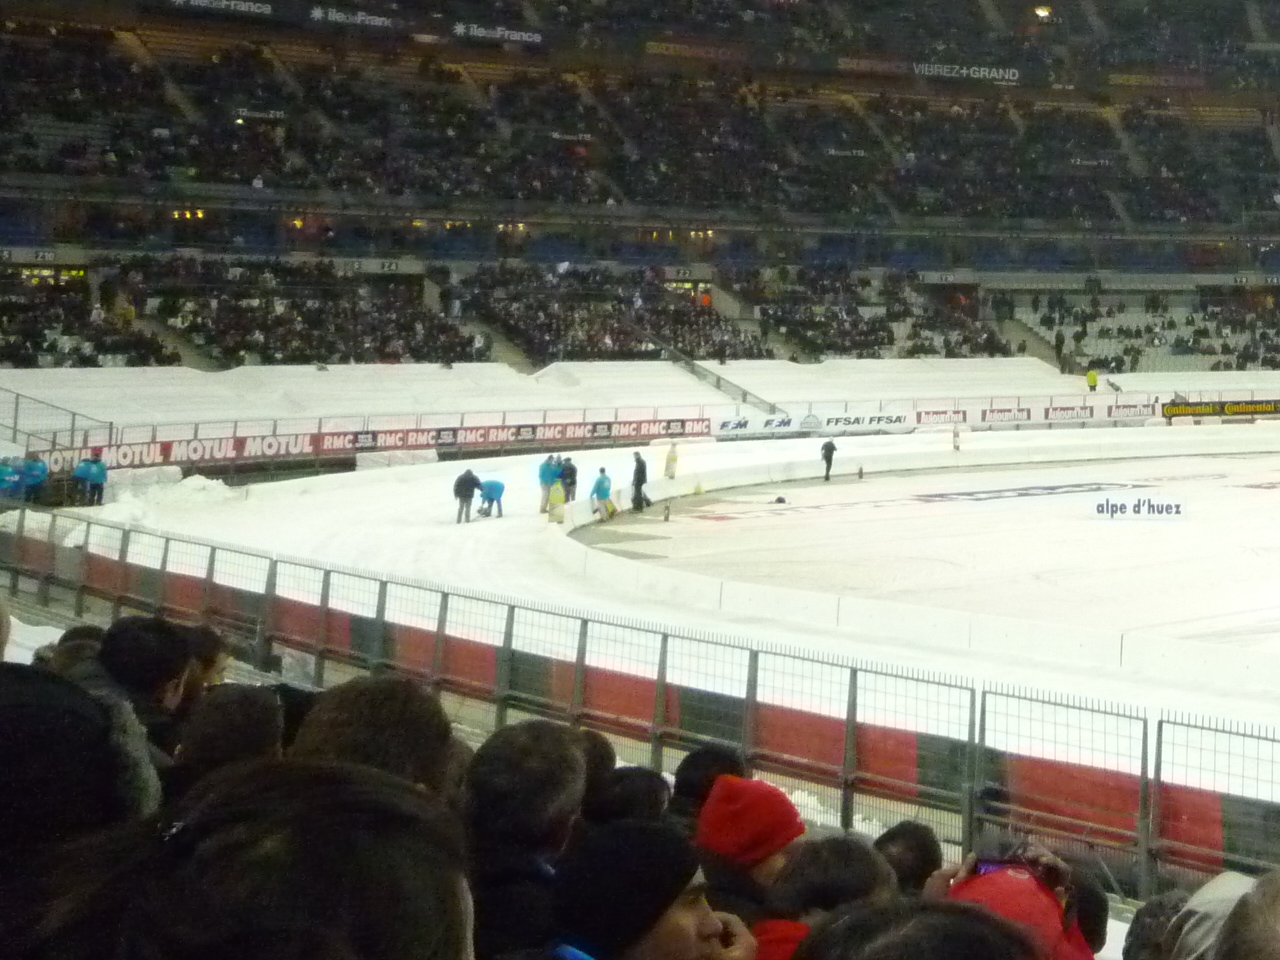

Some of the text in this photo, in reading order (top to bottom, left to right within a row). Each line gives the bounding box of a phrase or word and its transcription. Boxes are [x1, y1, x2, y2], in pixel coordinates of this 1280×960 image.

[913, 63, 1019, 81] VIBREZ+GRAND
[1164, 403, 1213, 416] Continental
[1224, 401, 1275, 414] Continental
[826, 416, 863, 426] FFSA
[869, 415, 905, 425] FFSA
[489, 428, 516, 442] RMC
[536, 426, 563, 439] RMC
[566, 424, 593, 438] RMC
[611, 423, 637, 436] RMC
[641, 421, 667, 435] RMC
[684, 421, 710, 435] RMC
[324, 434, 353, 449] RMC
[377, 432, 404, 446] RMC
[408, 430, 437, 445] RMC
[457, 429, 484, 443] RMC
[171, 439, 236, 461] MOTUL
[244, 434, 313, 456] MOTUL
[102, 444, 163, 468] MOTUL
[1096, 498, 1182, 519] alpe d'huez
